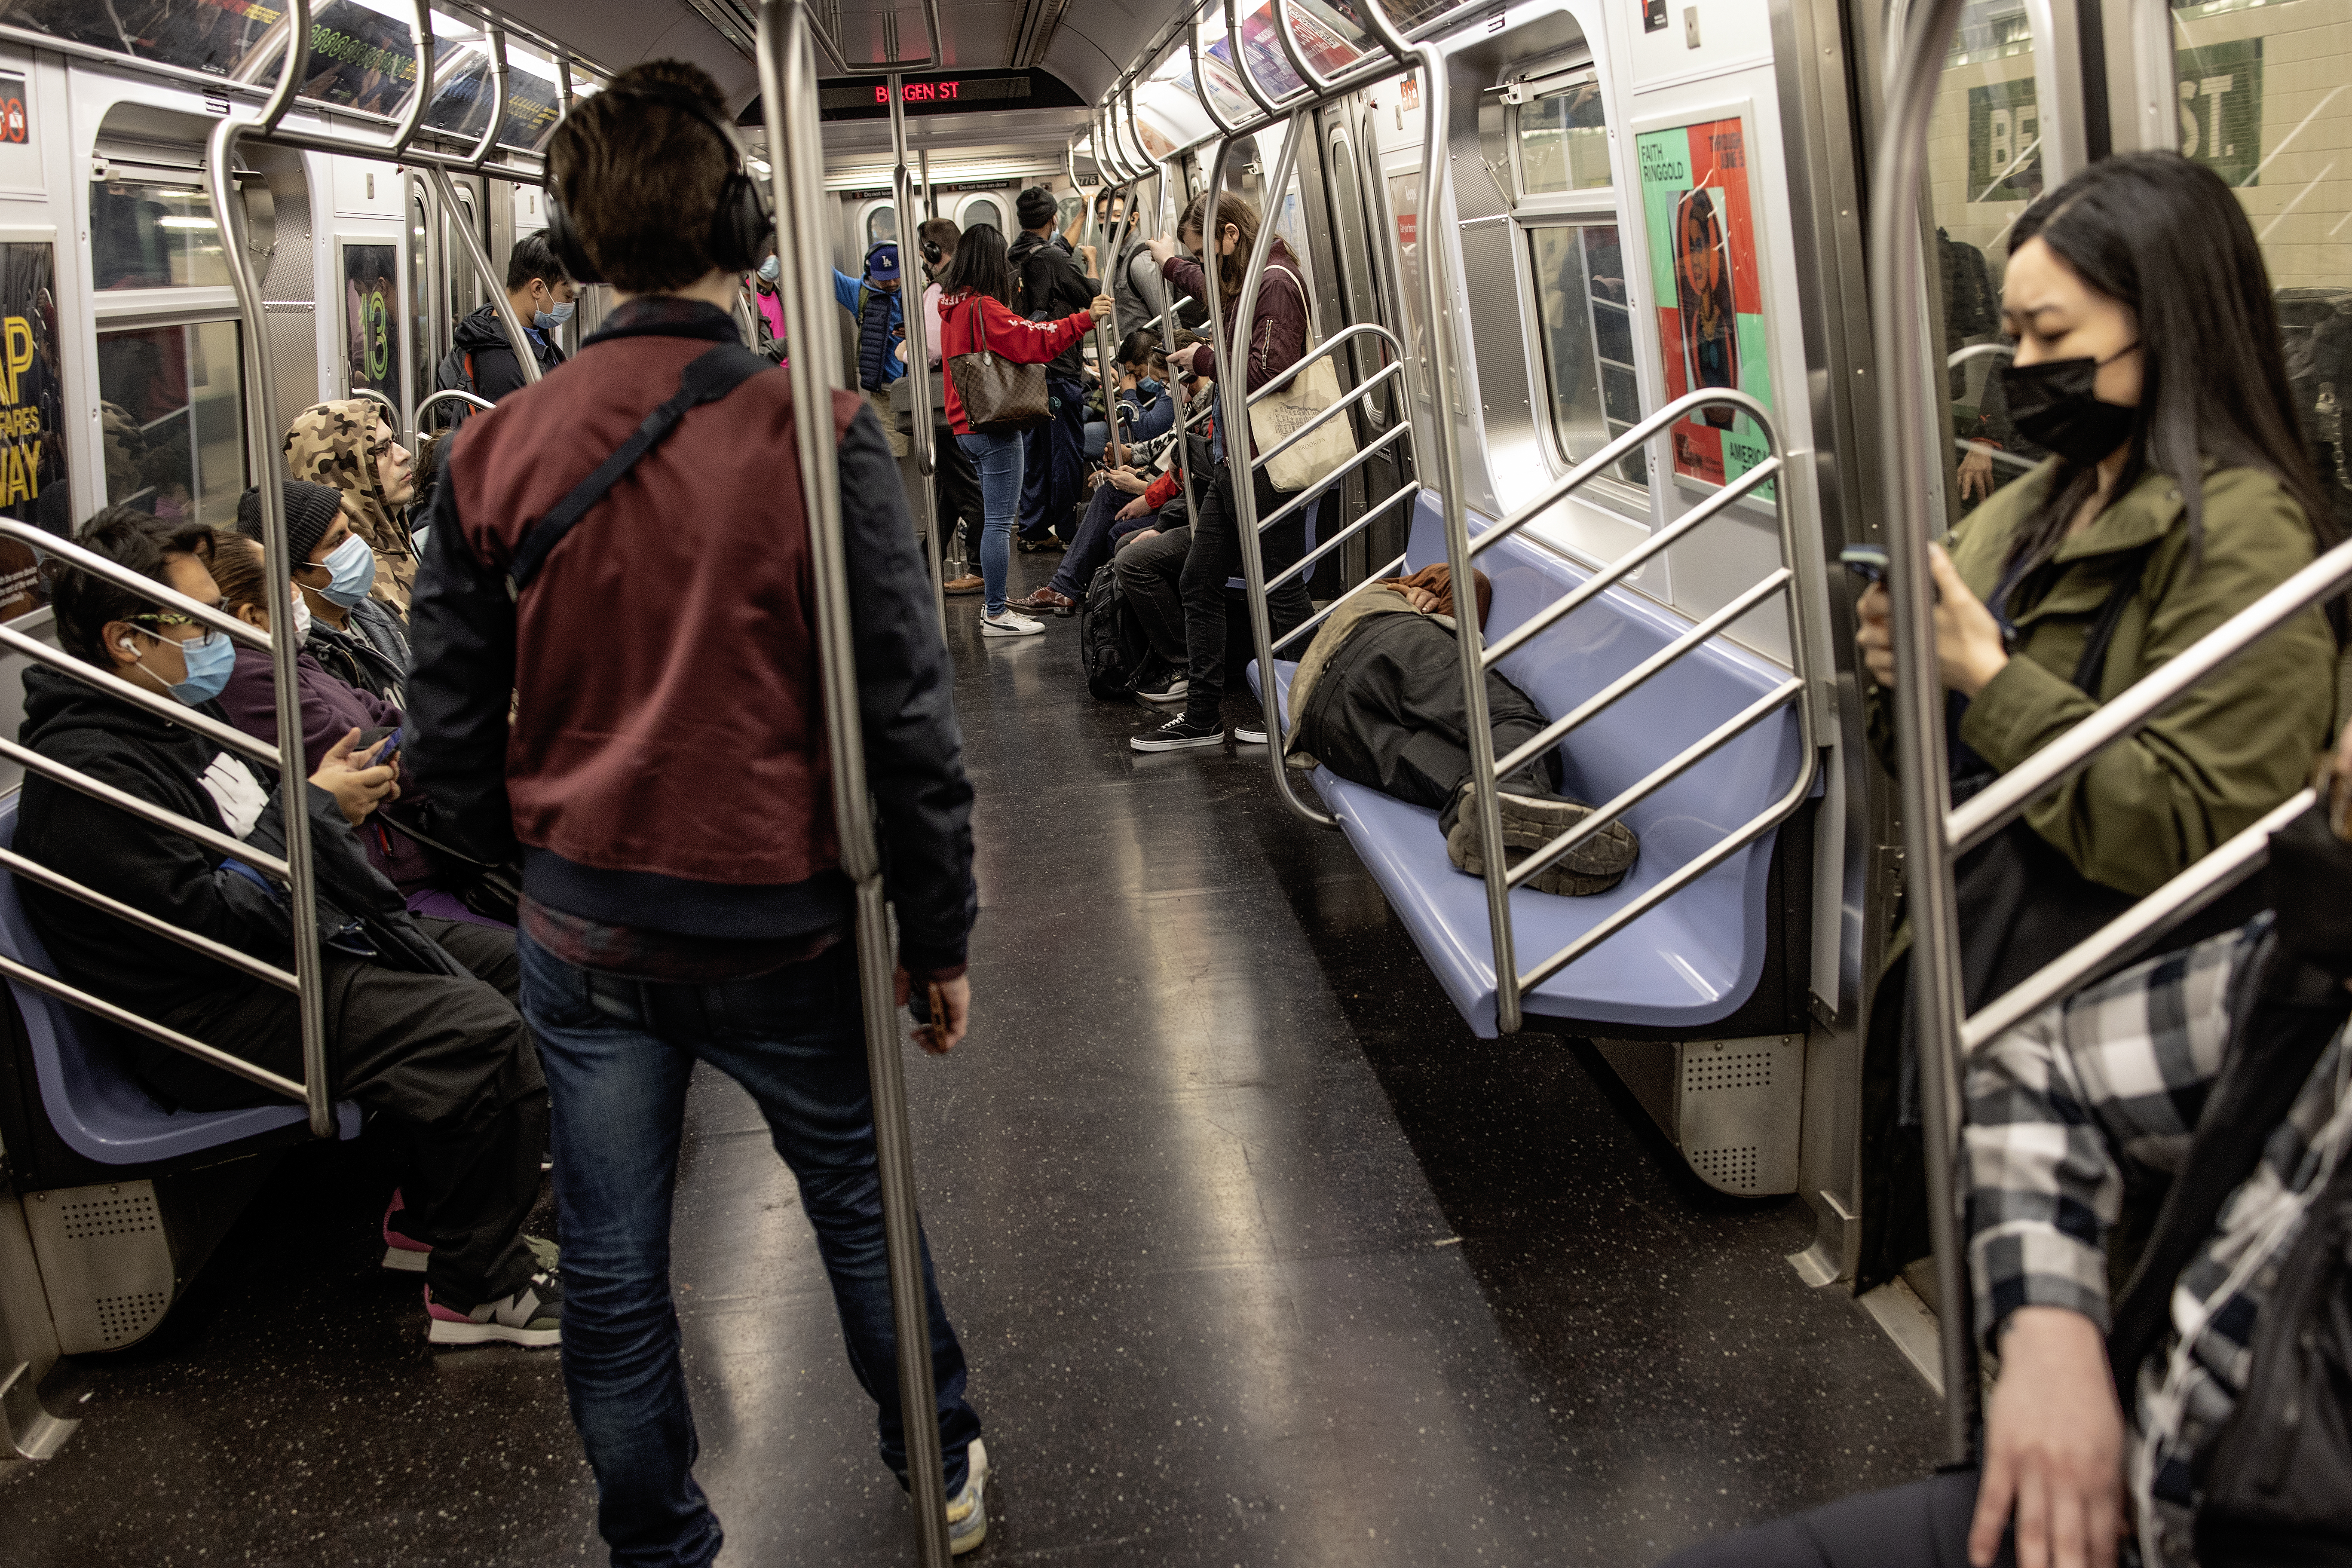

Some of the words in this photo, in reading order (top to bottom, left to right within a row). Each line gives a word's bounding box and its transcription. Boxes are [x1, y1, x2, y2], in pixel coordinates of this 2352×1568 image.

[876, 83, 935, 103] BGEN
[939, 82, 959, 98] ST
[1641, 143, 1663, 162] FAITH
[1643, 161, 1684, 182] RINGGOLD
[882, 256, 892, 267] LA
[1298, 438, 1326, 451] BROOKLYN
